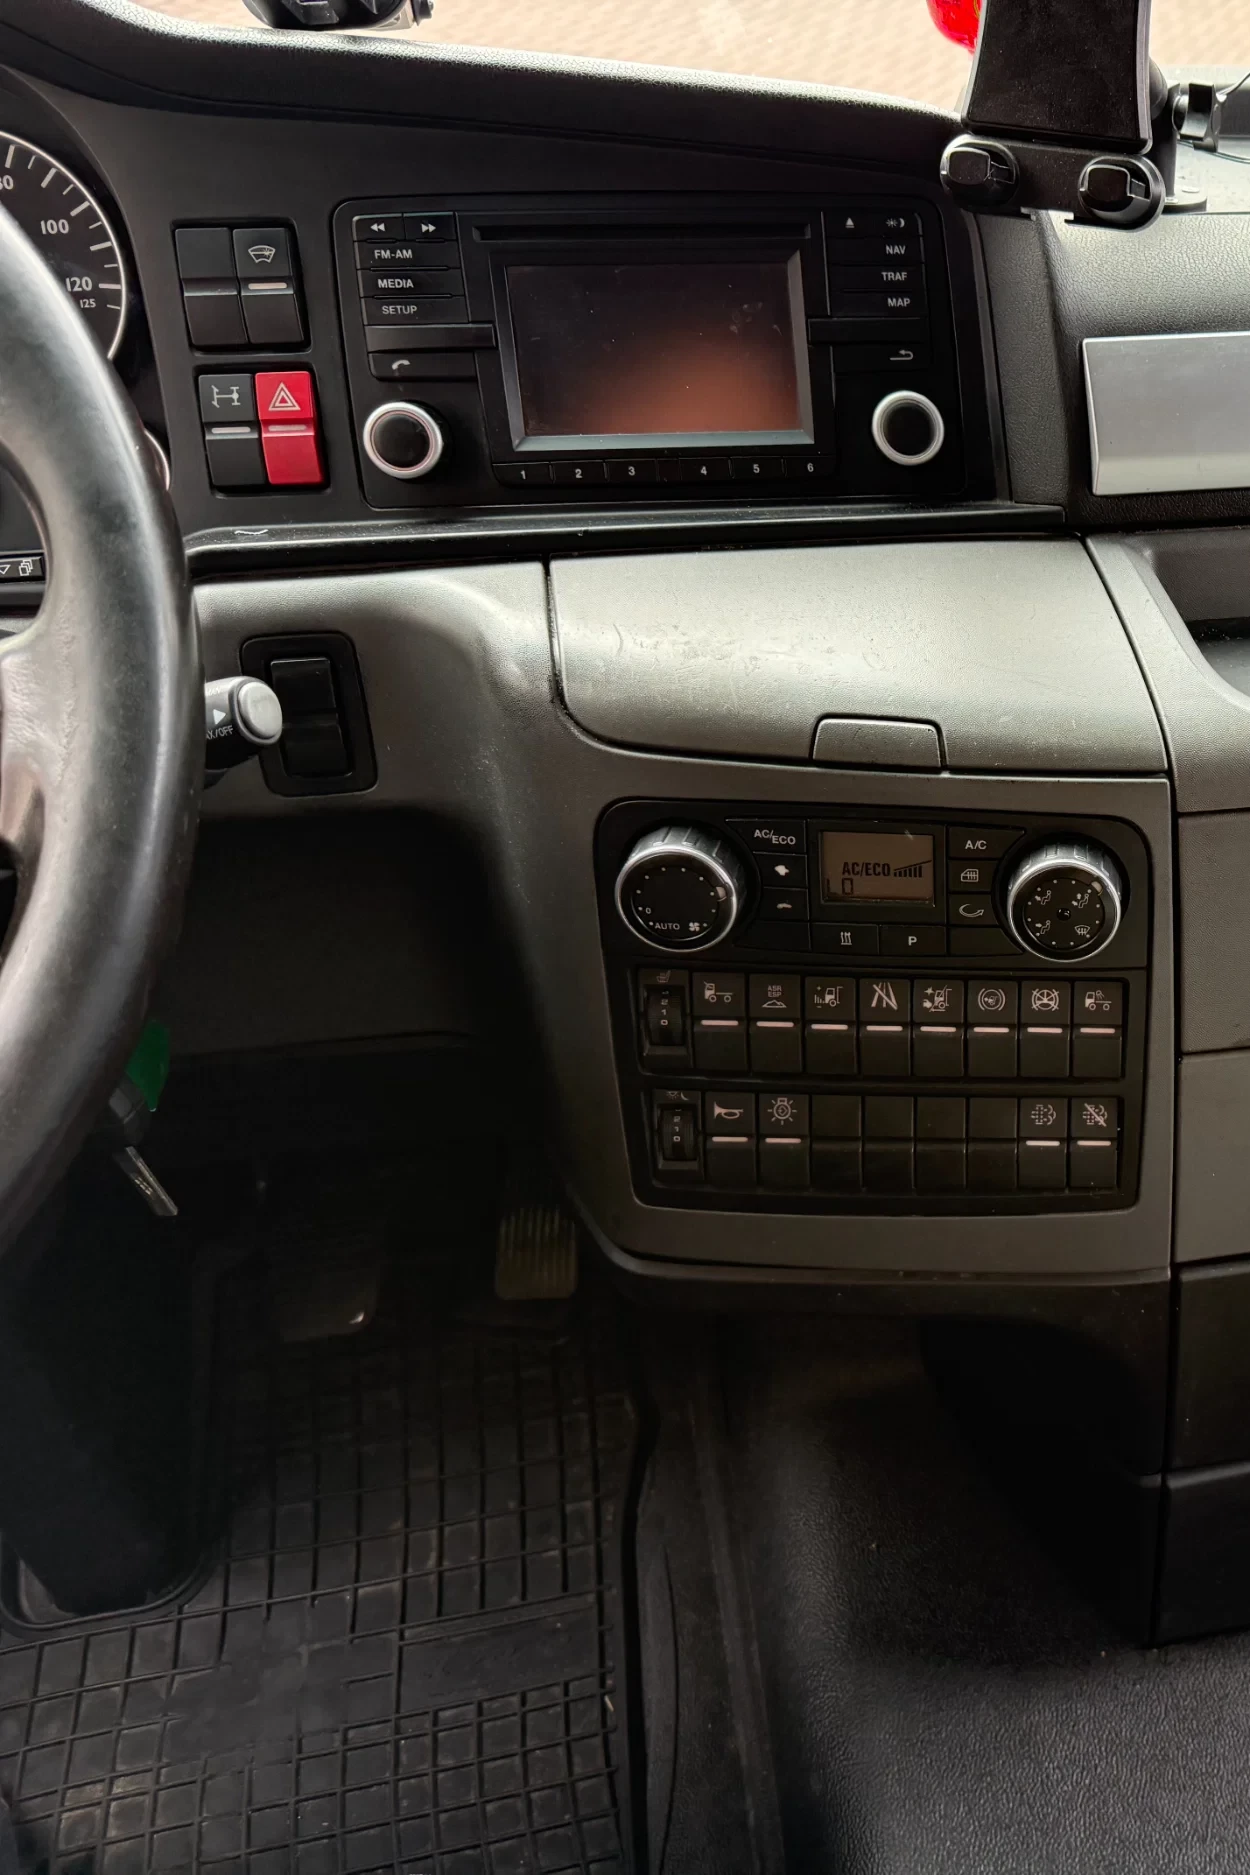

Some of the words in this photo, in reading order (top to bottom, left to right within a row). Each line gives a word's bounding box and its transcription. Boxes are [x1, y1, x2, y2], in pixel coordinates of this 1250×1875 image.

[40, 219, 70, 235] 100
[374, 249, 413, 260] FM-AM
[885, 245, 906, 255] NAV
[881, 271, 908, 281] TRAF
[65, 276, 93, 292] 120
[377, 278, 414, 289] MEDIA
[79, 298, 97, 309] 125
[887, 297, 911, 307] MAP
[381, 305, 418, 315] SETUP
[520, 470, 526, 480] 1
[575, 468, 583, 479] 2
[628, 465, 636, 476] 3
[700, 465, 708, 476] 4
[753, 463, 760, 473] 5
[807, 462, 814, 472] 6
[964, 839, 988, 850] A/C
[841, 861, 892, 878] AC/ECO
[654, 922, 681, 931] AUTO
[908, 936, 918, 946] P
[767, 984, 782, 992] ASR
